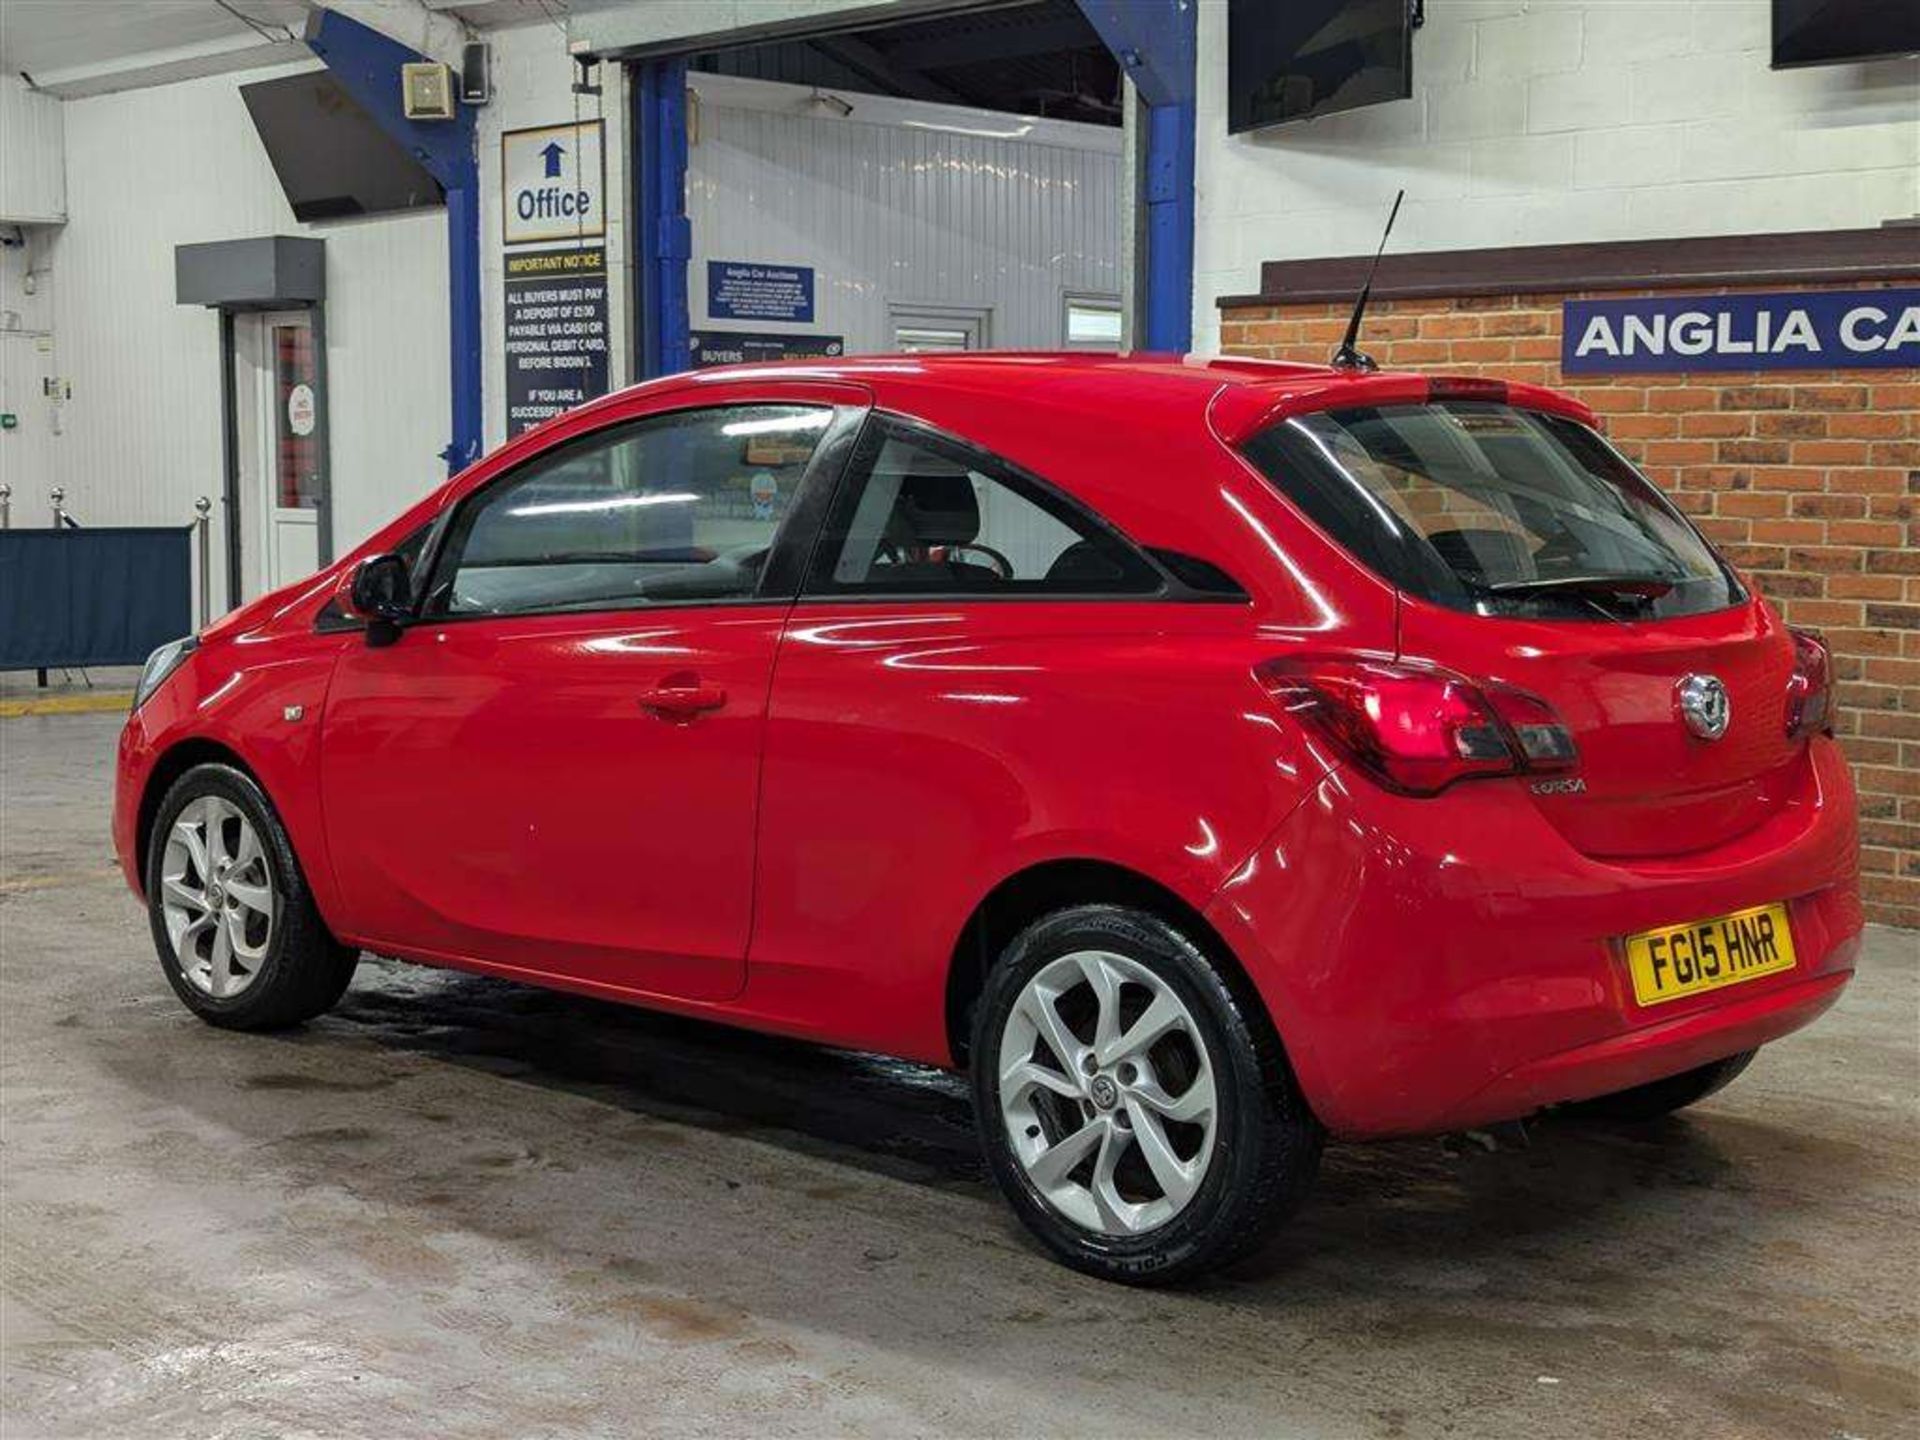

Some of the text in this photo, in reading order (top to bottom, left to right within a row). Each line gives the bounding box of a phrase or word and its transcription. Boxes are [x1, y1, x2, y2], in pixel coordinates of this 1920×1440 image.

[518, 187, 589, 220] Office
[509, 253, 601, 272] IMPORTANT NOTICE
[508, 288, 603, 304] ALL BUYERS MUST PAY
[515, 308, 522, 320] A
[523, 306, 559, 319] DEPOSIT
[560, 305, 572, 318] OF
[508, 323, 546, 336] PAYABLE
[547, 322, 562, 335] VIA
[589, 321, 603, 333] OR
[1575, 310, 1822, 357] ANGLIA
[506, 341, 550, 353] PERSONAL
[551, 339, 577, 351] DEBIT
[519, 357, 552, 369] BEFORE
[702, 350, 744, 362] BUYERS
[528, 389, 584, 401] IF YOU ARE A
[1530, 779, 1587, 795] CORSA
[1648, 912, 1780, 990] FG15 HNR
